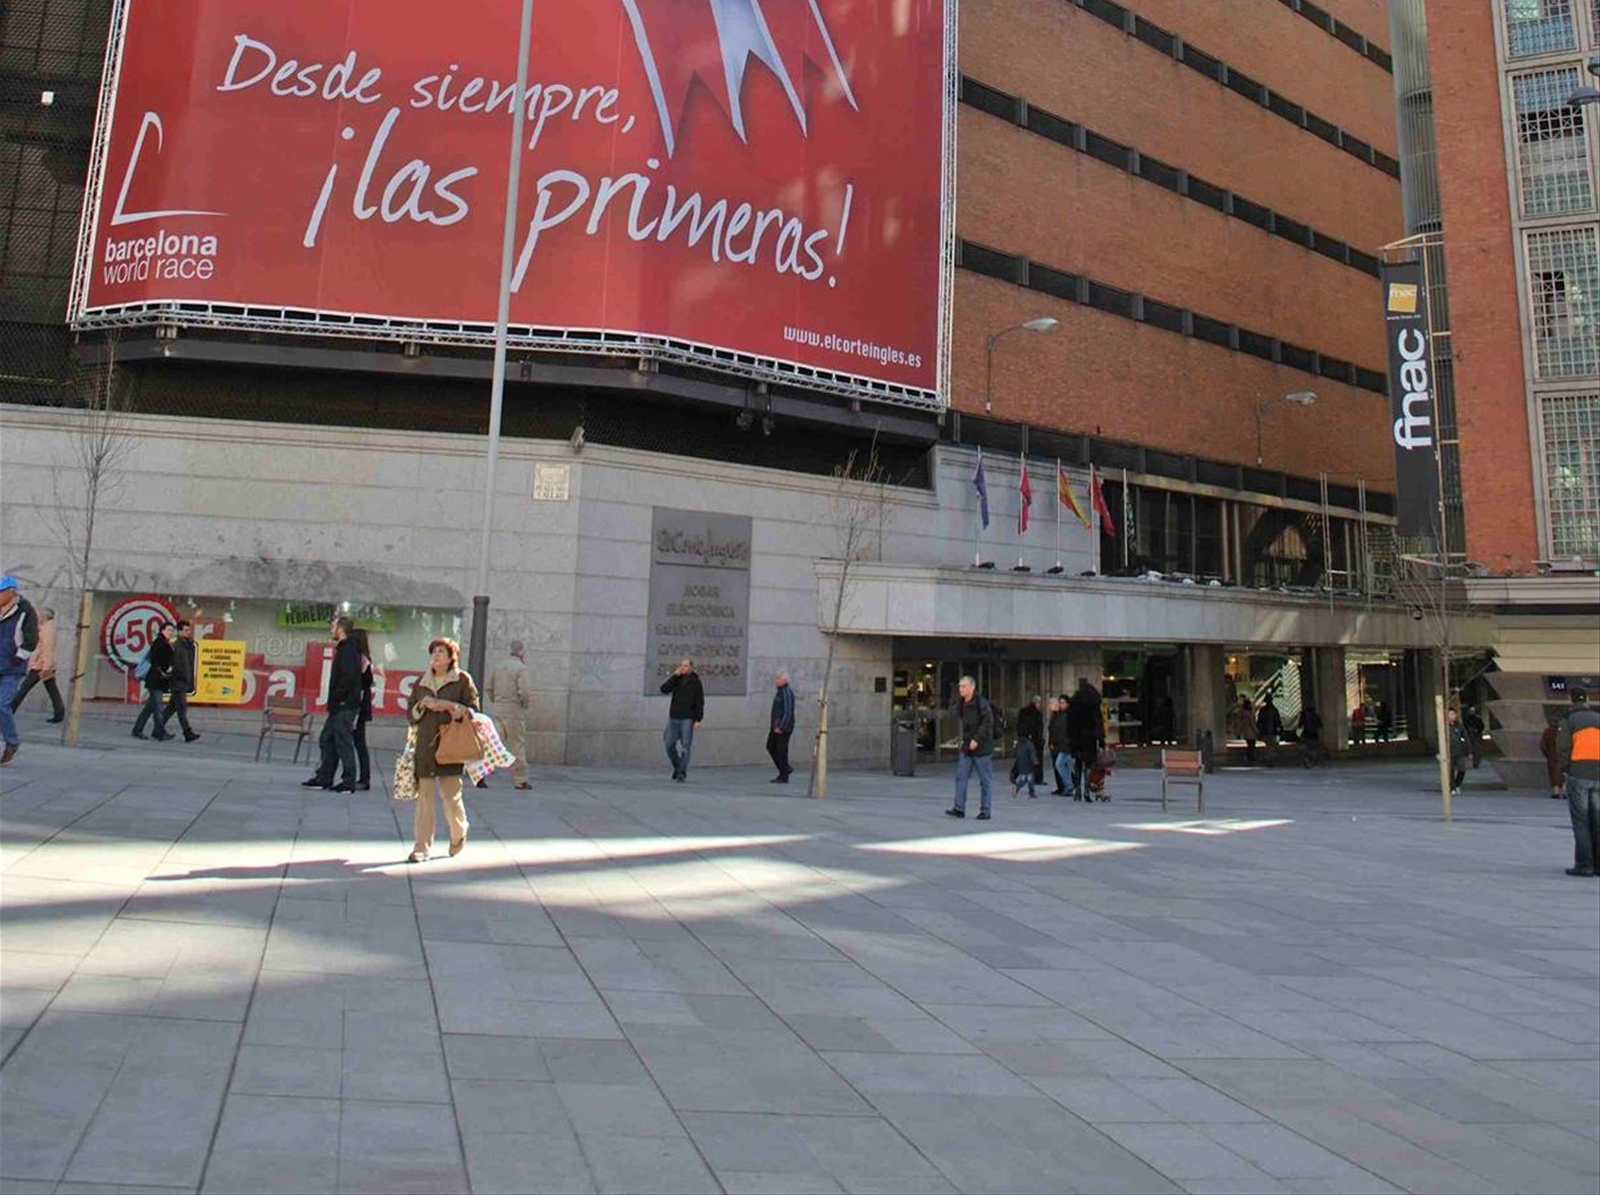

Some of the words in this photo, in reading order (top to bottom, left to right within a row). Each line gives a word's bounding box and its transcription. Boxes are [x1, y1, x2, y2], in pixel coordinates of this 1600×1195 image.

[216, 33, 383, 104] Desde
[410, 63, 636, 151] siempre,
[303, 106, 479, 249] ¡las
[510, 157, 854, 293] primeras!
[103, 255, 151, 285] world
[155, 257, 214, 280] race
[104, 229, 218, 263] barcelona
[783, 325, 922, 368] www.elcorteingles.es
[1393, 327, 1433, 450] fnac
